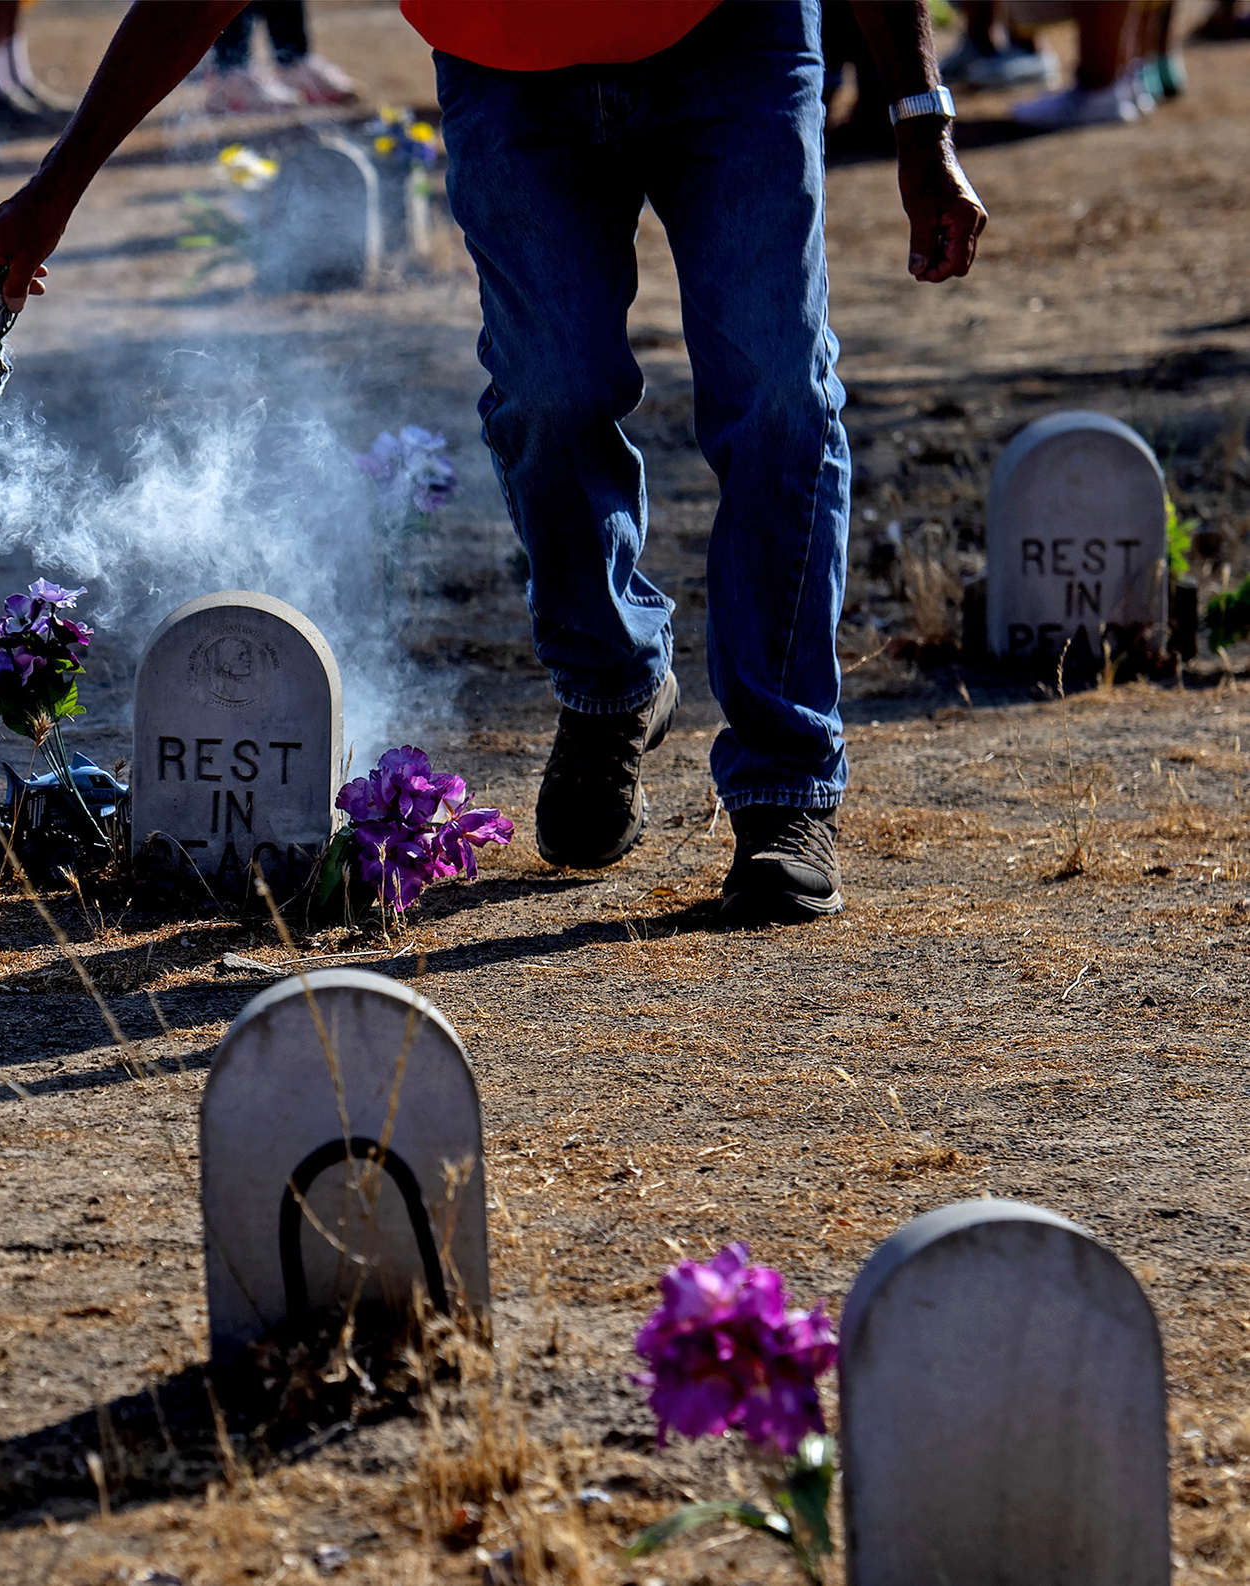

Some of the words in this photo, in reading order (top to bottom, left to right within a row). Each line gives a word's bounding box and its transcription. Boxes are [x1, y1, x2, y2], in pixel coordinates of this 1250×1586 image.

[1020, 537, 1142, 577] REST
[1065, 580, 1102, 619] IN
[157, 736, 303, 785] REST
[212, 790, 255, 835] IN
